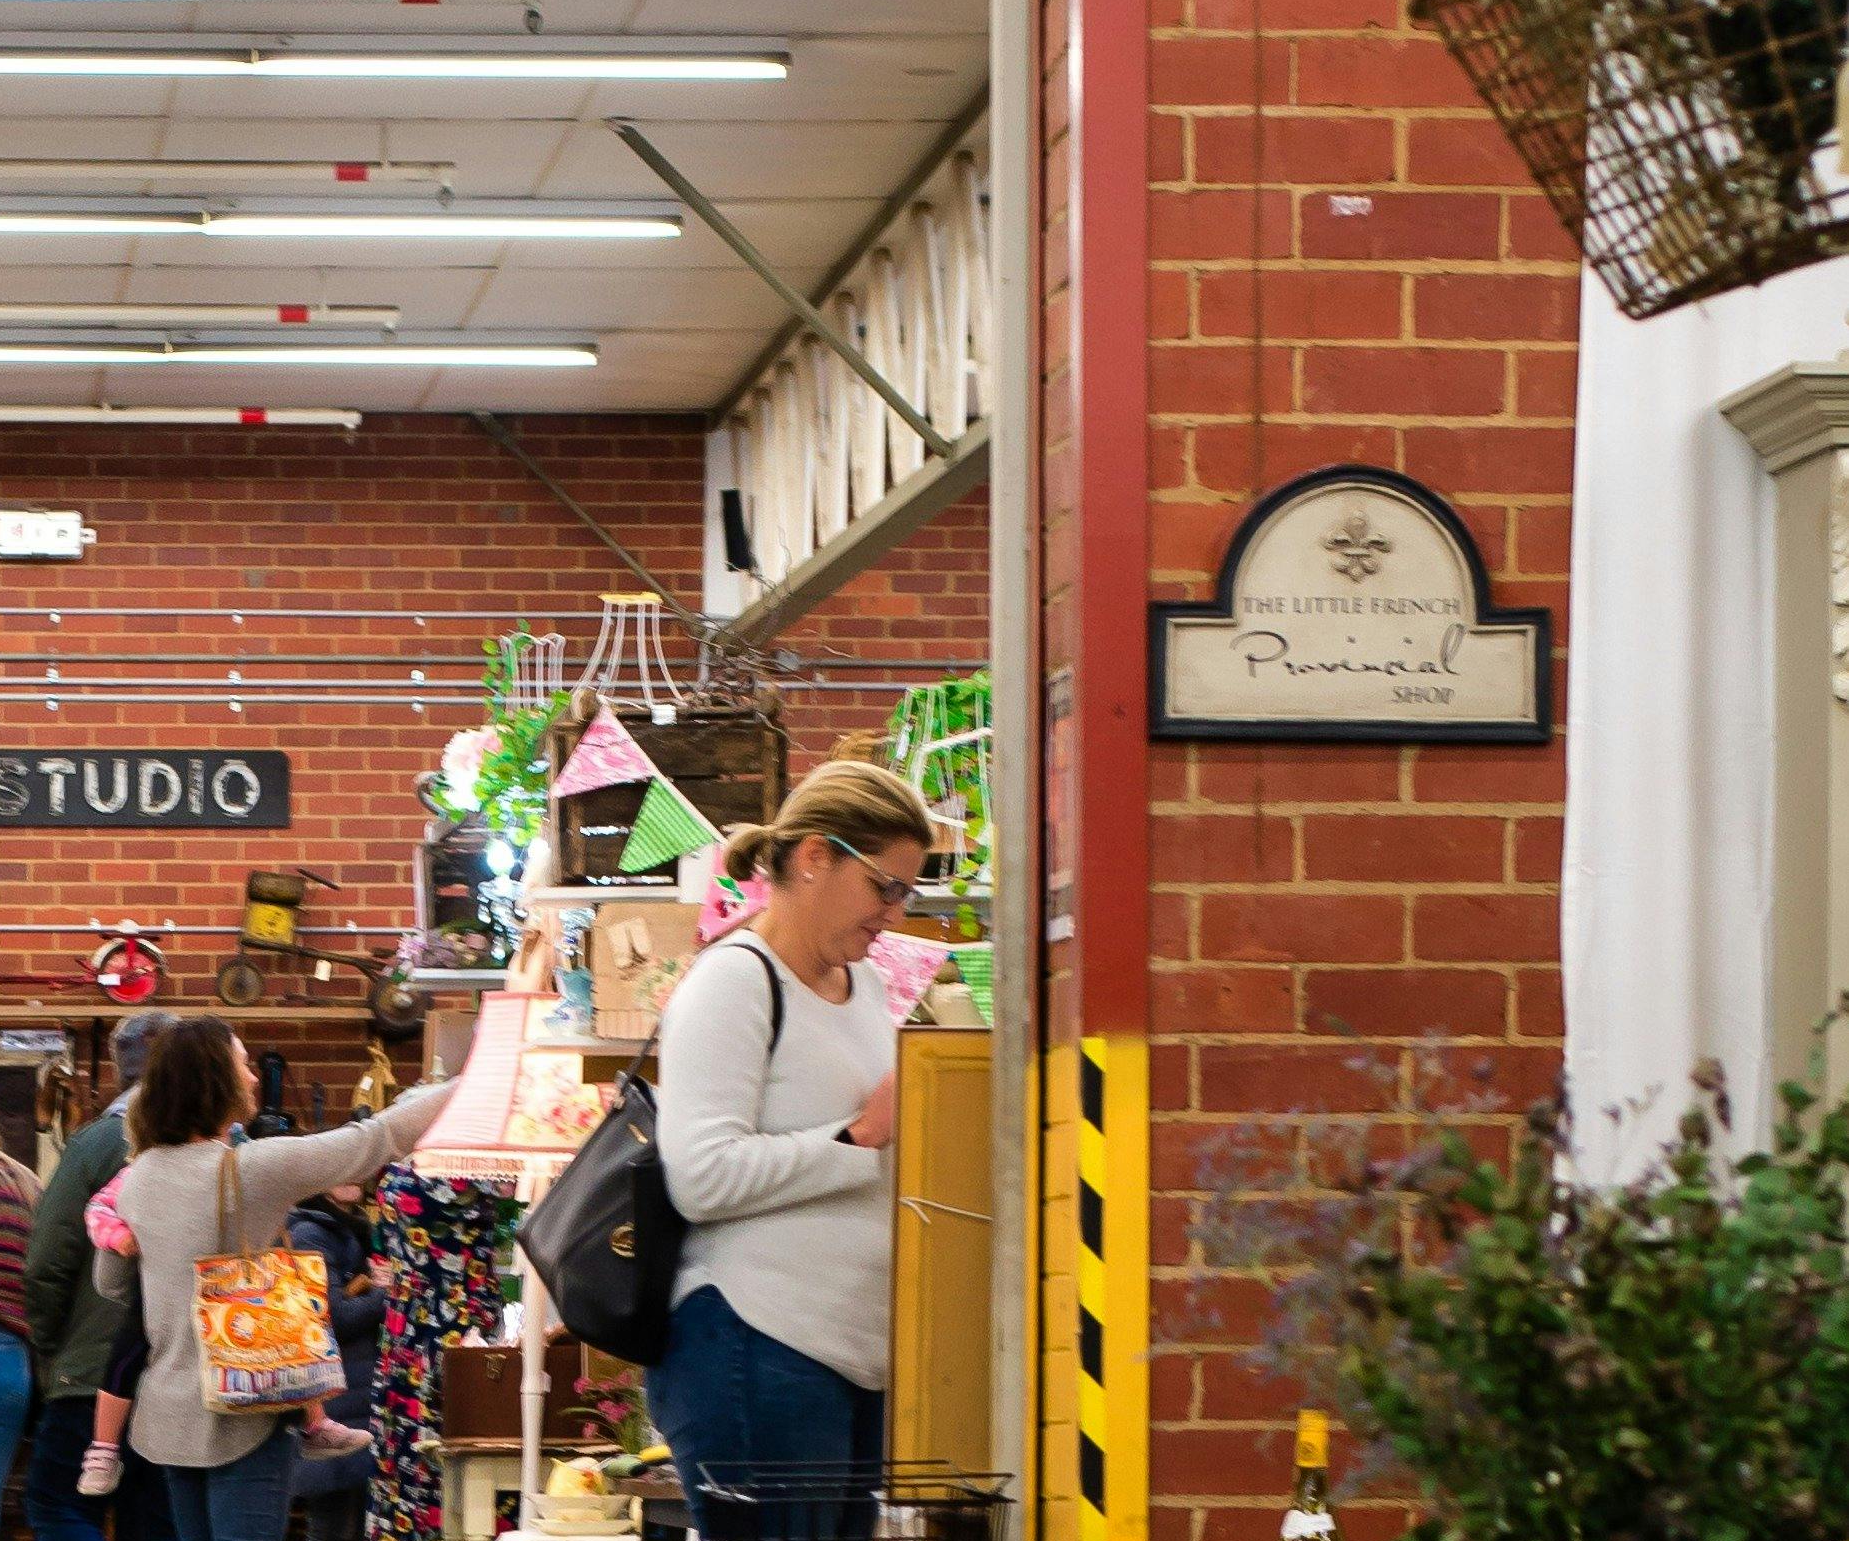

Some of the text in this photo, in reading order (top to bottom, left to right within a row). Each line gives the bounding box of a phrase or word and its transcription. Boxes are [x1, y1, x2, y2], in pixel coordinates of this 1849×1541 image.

[1243, 596, 1461, 615] THE LITTLE FRENCH
[1229, 622, 1466, 678] Provincial
[1391, 685, 1455, 704] SHOP
